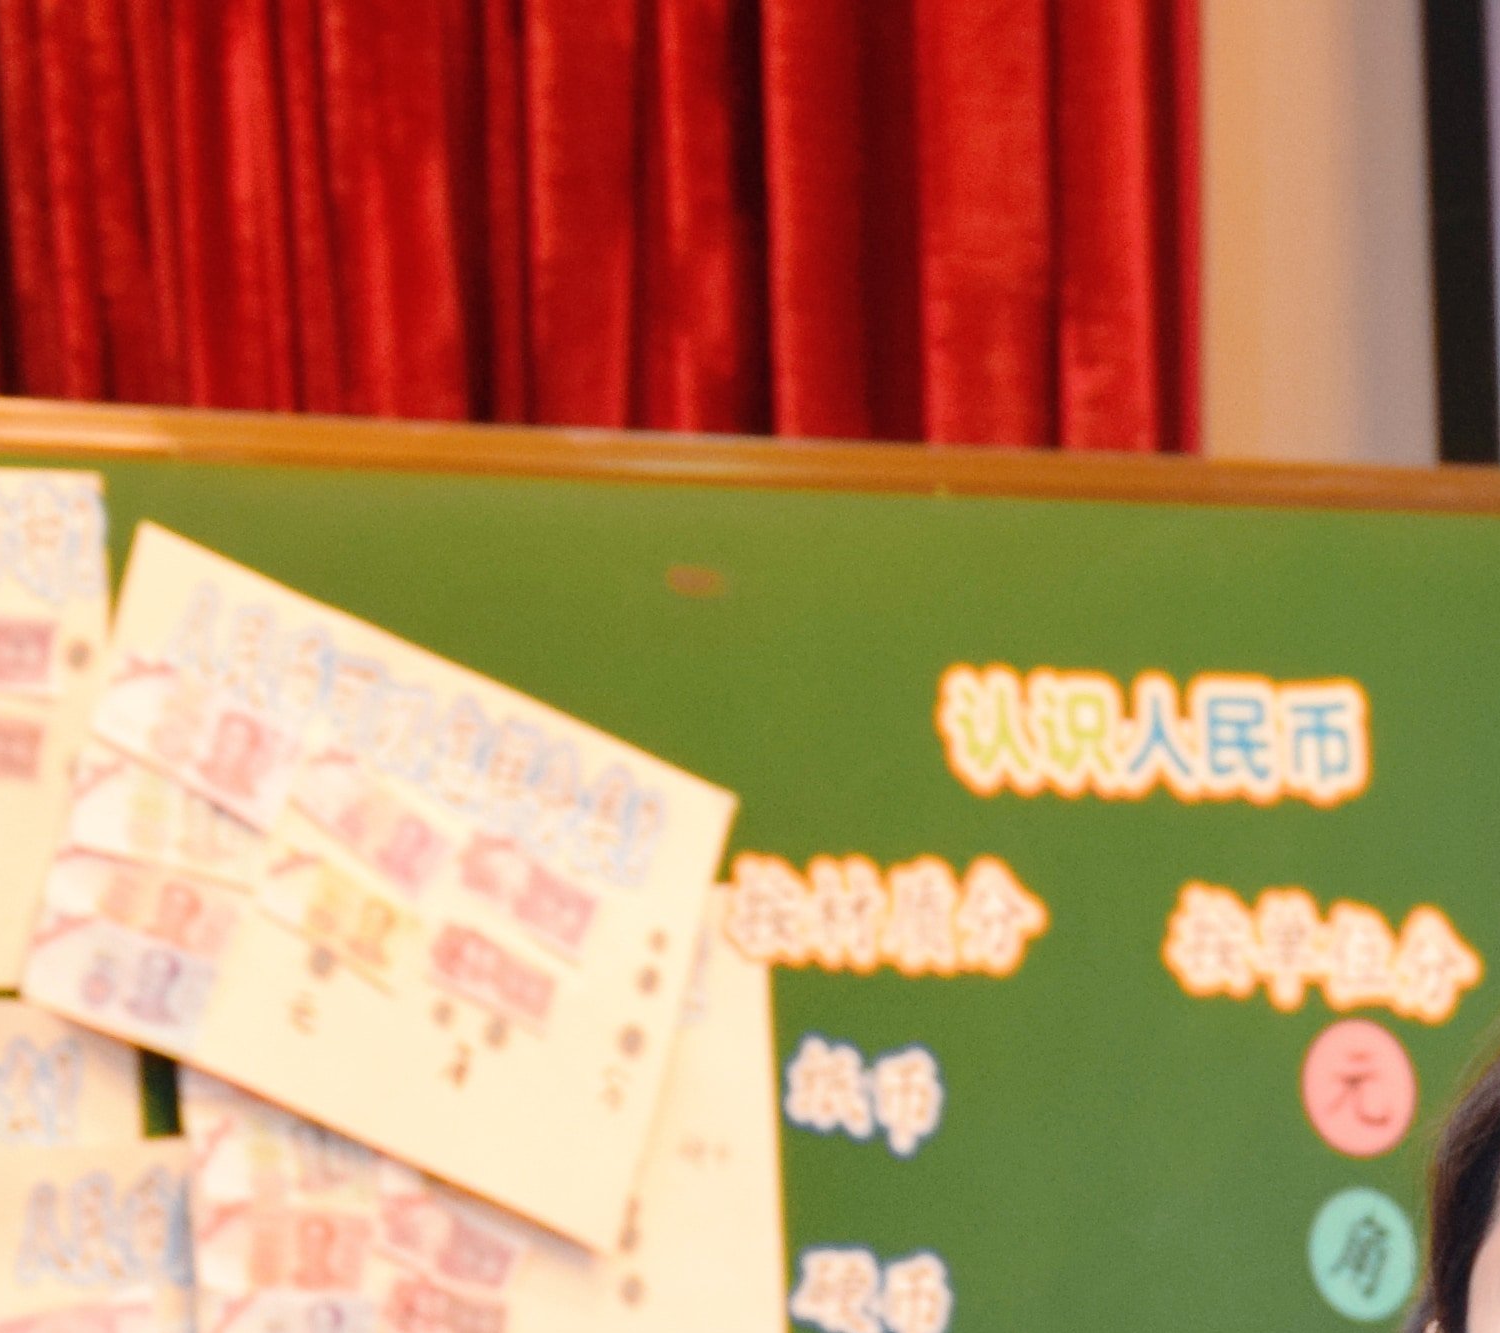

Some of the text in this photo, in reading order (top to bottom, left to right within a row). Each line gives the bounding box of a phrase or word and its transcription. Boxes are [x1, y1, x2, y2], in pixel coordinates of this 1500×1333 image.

[948, 678, 1362, 794] 认识人民币
[1326, 1050, 1392, 1128] 元
